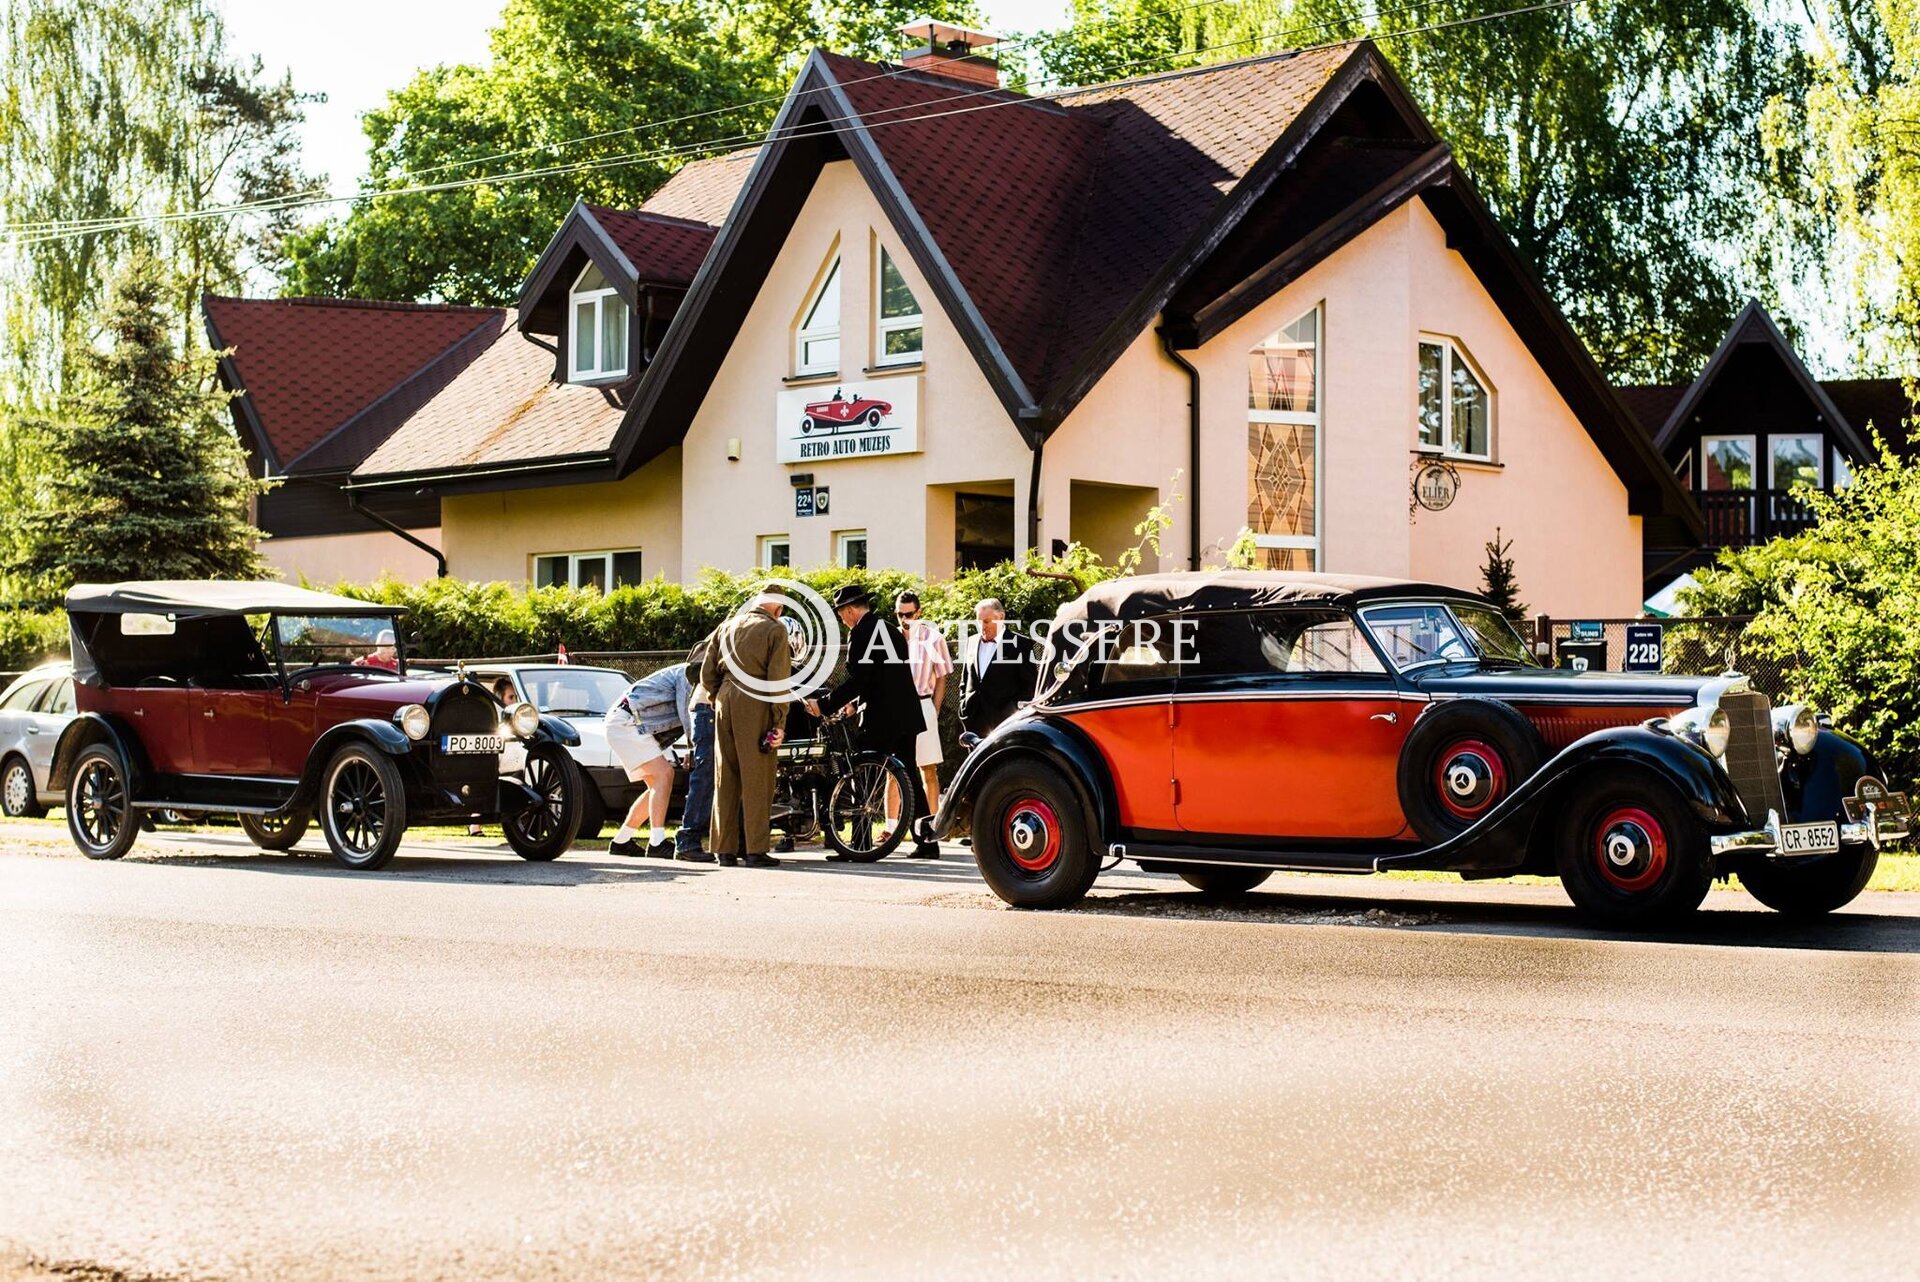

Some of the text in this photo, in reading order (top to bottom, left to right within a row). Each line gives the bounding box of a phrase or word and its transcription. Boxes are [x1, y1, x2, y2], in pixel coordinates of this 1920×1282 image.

[800, 435, 891, 458] RETRO AUTO MUZEJS
[797, 494, 812, 507] 22A
[1629, 643, 1660, 664] 22B
